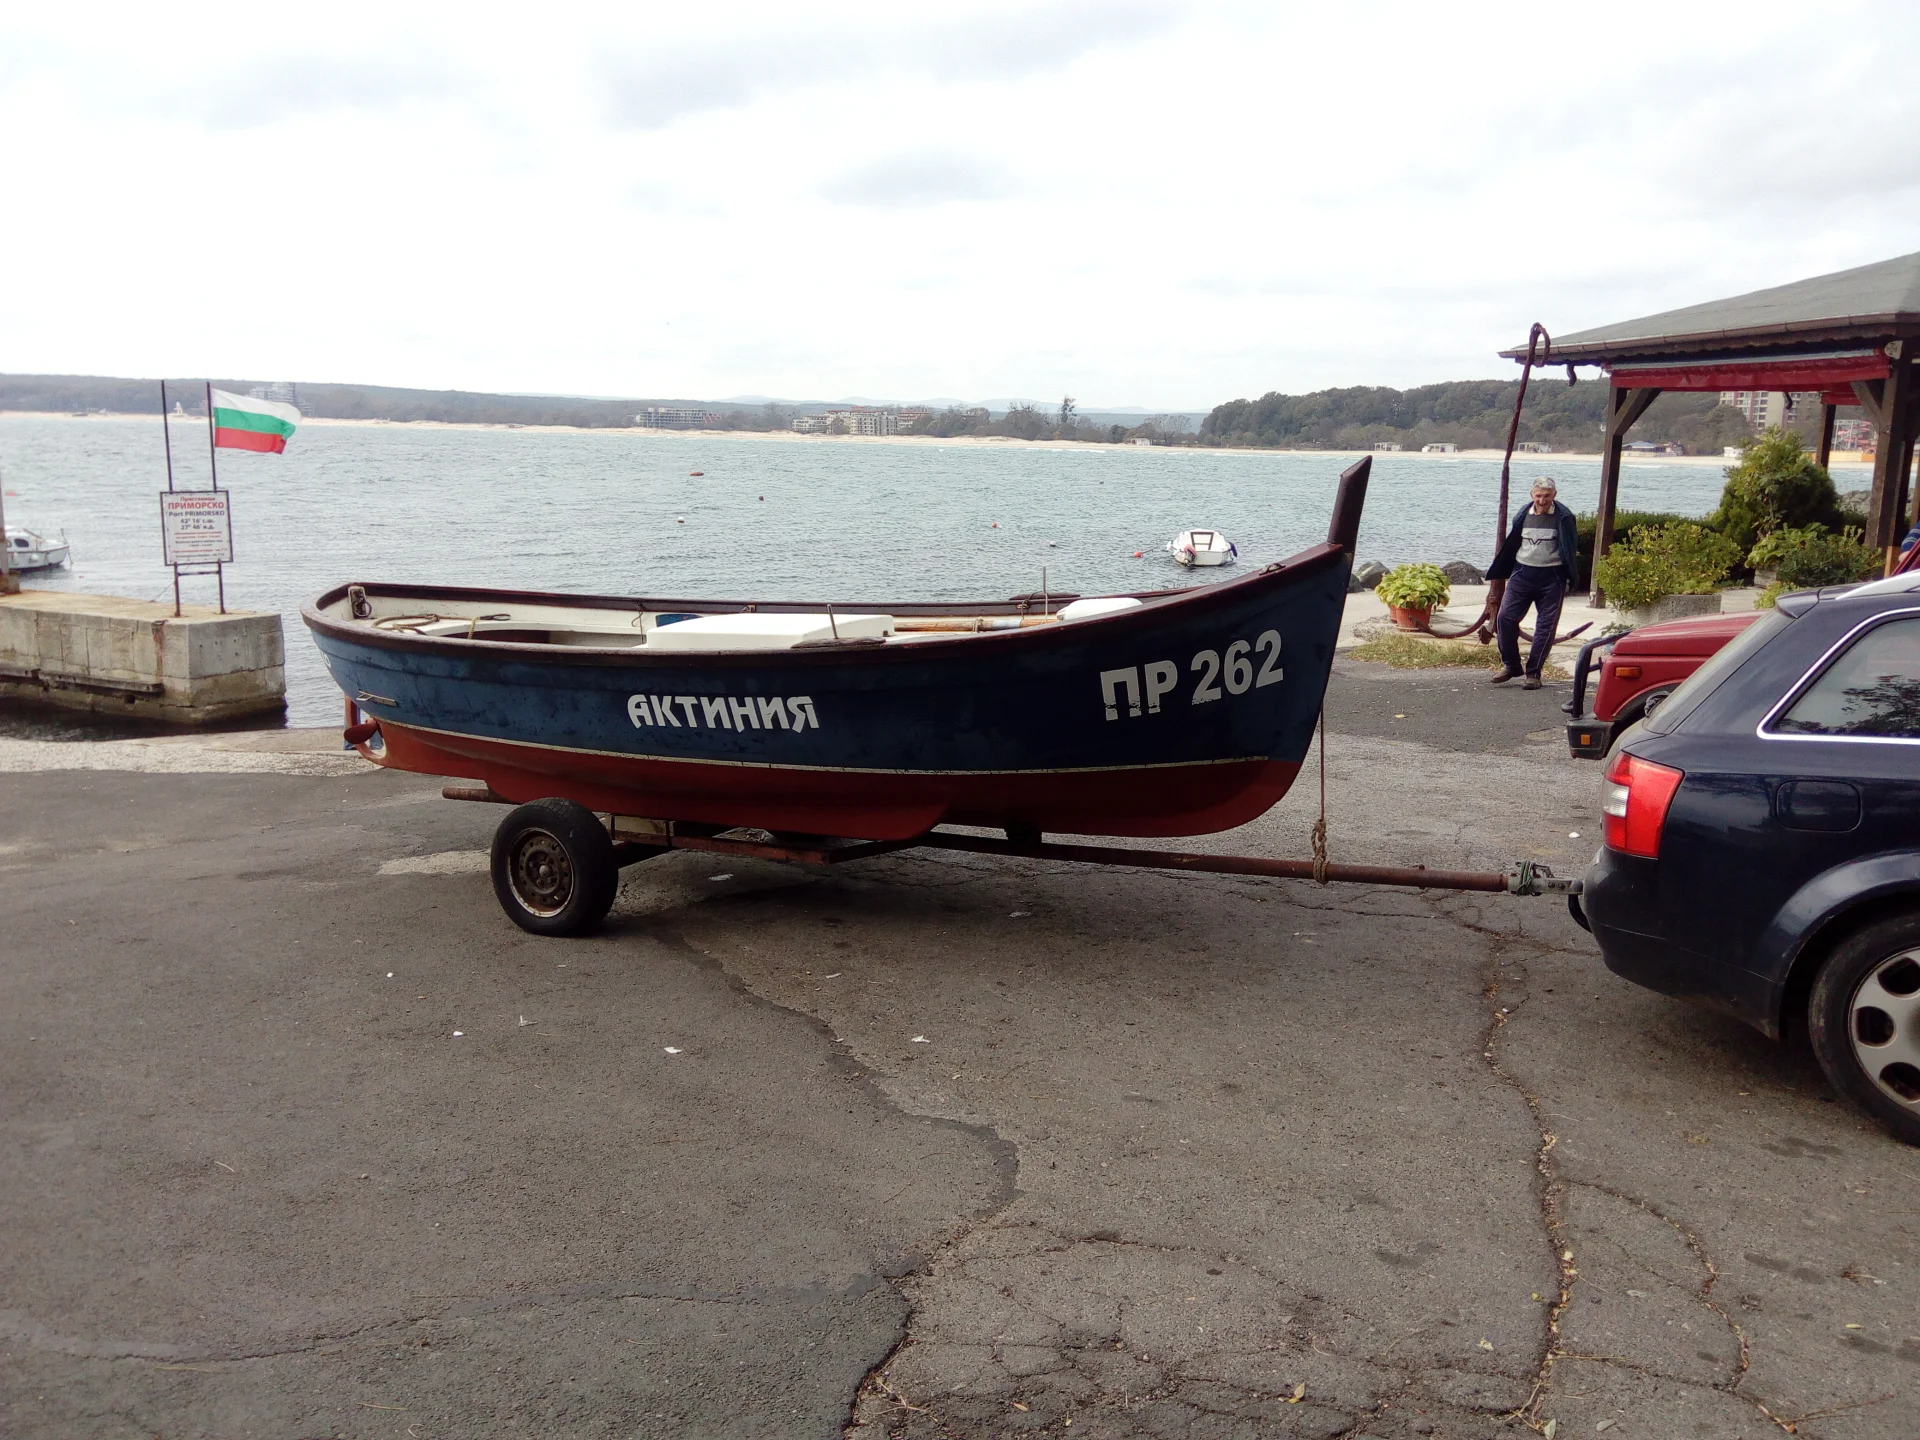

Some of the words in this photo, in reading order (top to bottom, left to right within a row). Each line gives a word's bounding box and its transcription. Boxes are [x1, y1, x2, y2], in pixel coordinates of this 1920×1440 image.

[168, 501, 225, 510] ПРИМОРСКО
[1100, 660, 1178, 721] ПР
[1190, 629, 1284, 706] 262
[627, 694, 820, 733] АКТИНИЯ
